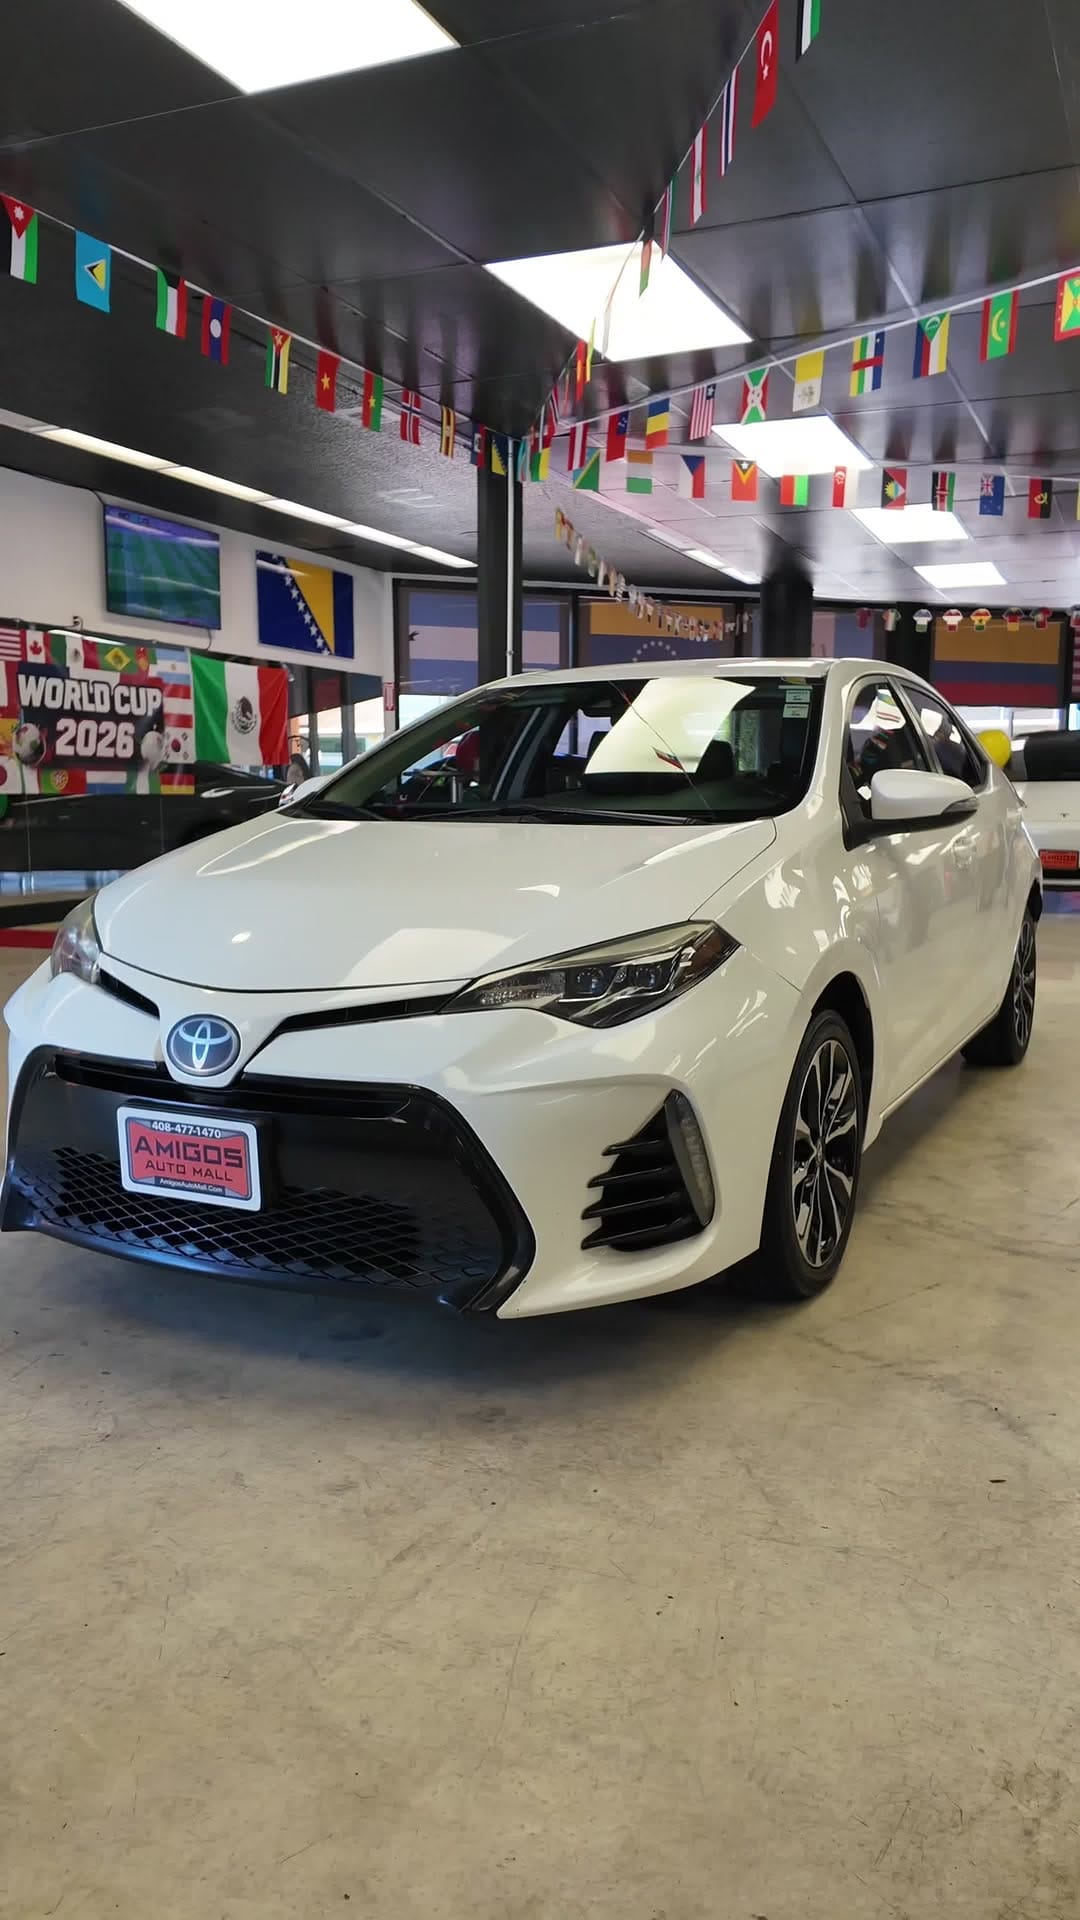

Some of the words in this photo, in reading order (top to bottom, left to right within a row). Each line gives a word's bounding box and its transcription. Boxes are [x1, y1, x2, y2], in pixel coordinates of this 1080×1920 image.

[17, 674, 112, 714] WORLD
[114, 684, 163, 717] CUP
[55, 718, 136, 759] 2026
[151, 1121, 222, 1139] 408-477-1470
[134, 1136, 243, 1169] AMIGOS
[145, 1160, 186, 1175] AUTO
[192, 1167, 233, 1182] MALL
